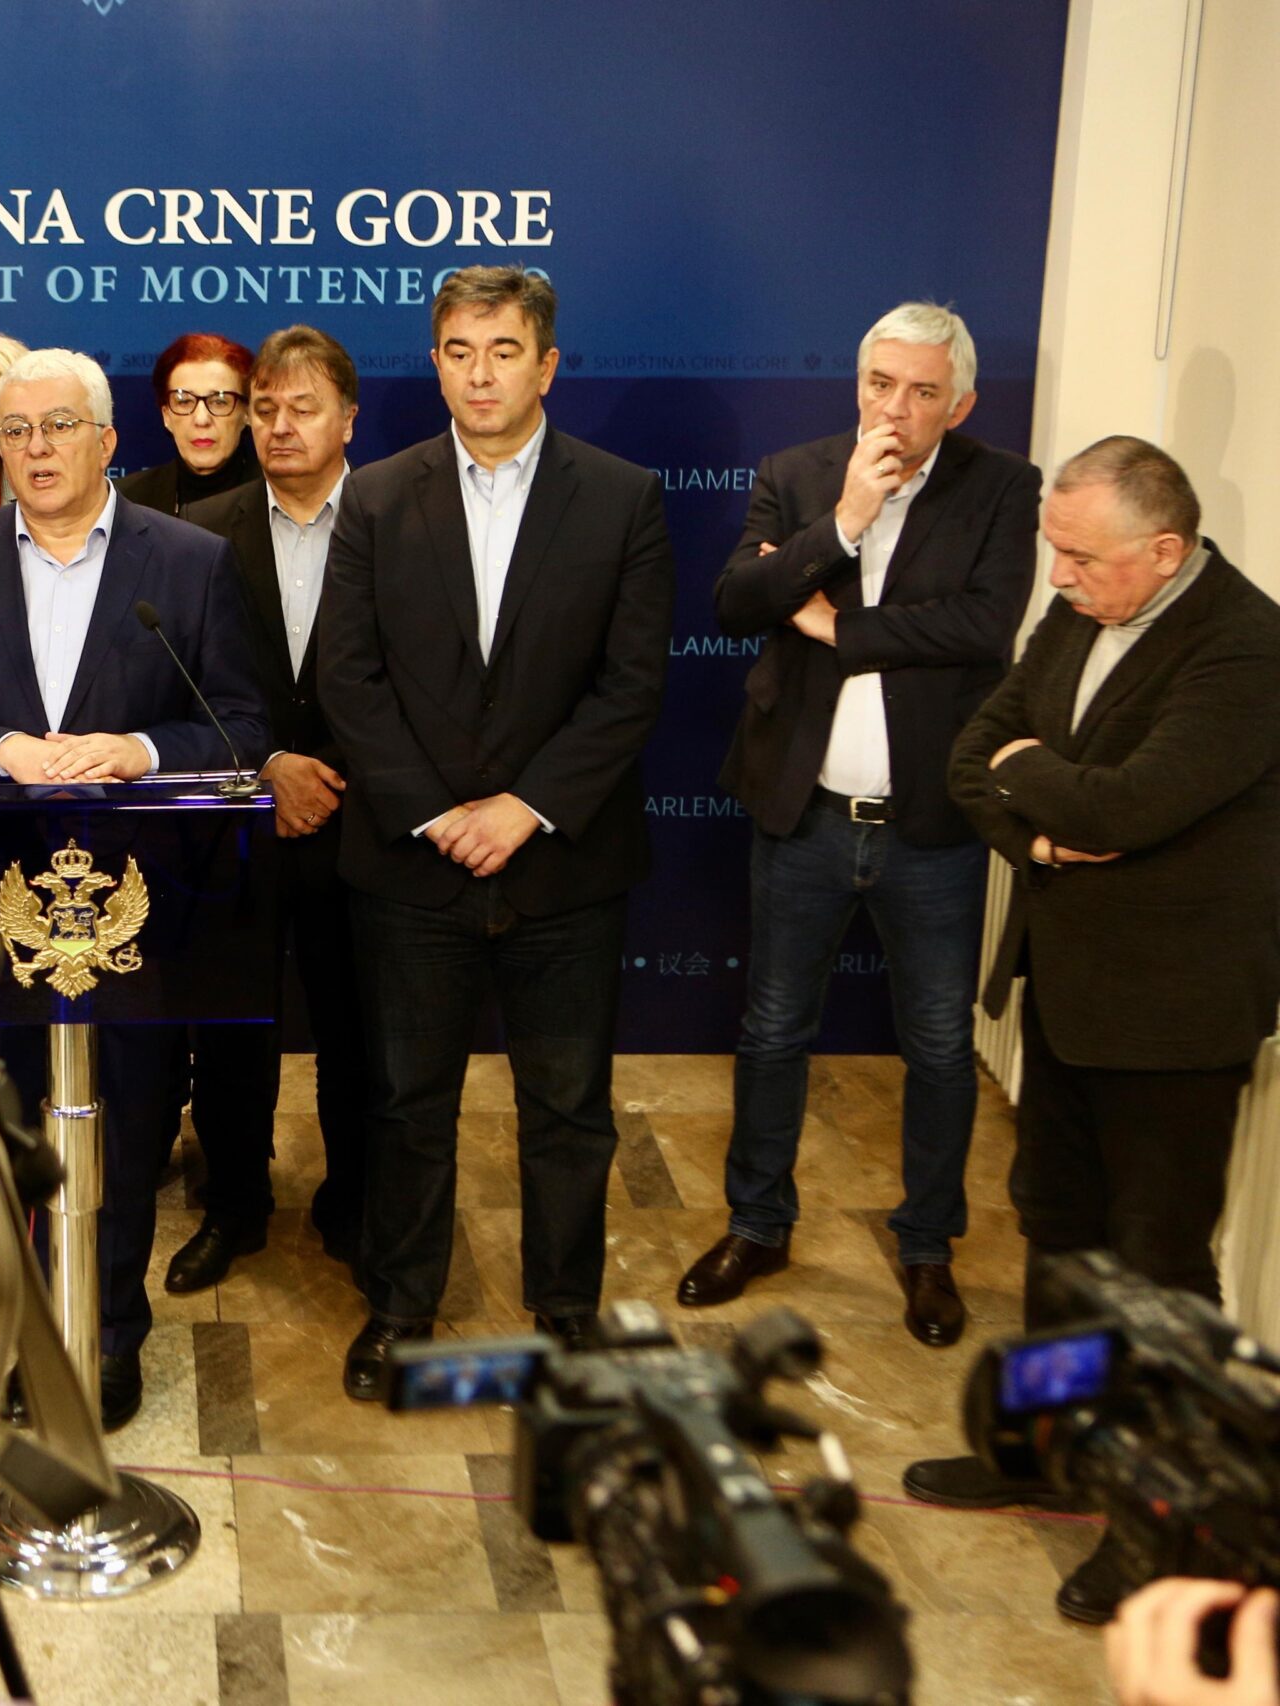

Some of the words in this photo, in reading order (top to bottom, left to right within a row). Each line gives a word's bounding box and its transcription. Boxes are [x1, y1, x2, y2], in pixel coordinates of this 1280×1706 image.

[103, 187, 316, 246] CRNE
[335, 188, 554, 247] GORE
[45, 266, 118, 303] OF
[141, 266, 552, 304] MONTENE
[657, 952, 711, 977] 议会
